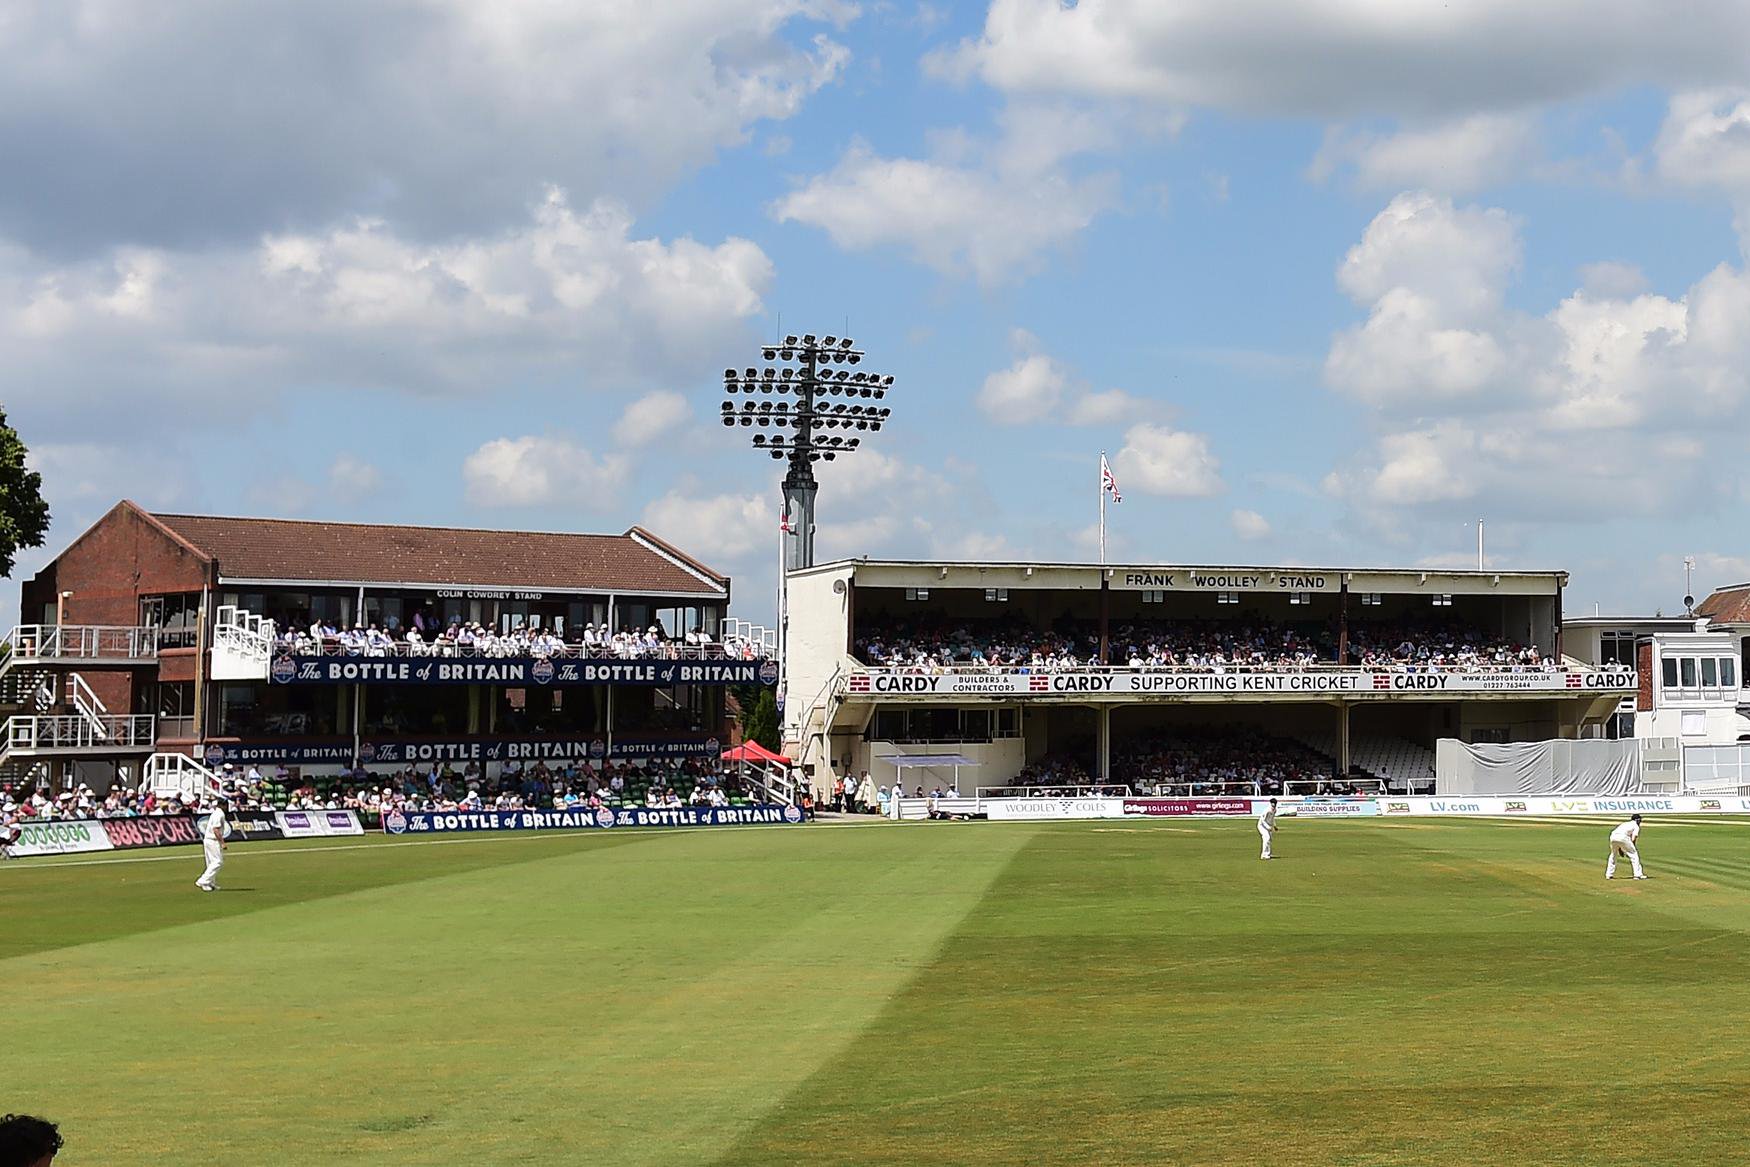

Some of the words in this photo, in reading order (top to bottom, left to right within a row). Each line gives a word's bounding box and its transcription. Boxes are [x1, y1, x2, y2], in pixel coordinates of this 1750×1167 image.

[1126, 575, 1174, 586] FRANK
[1195, 576, 1260, 588] WOOLLEY
[1280, 577, 1325, 588] STAND
[437, 590, 464, 598] COLIN
[467, 591, 510, 599] COWDREY
[298, 662, 322, 680] The
[329, 663, 410, 680] BOTTLE
[416, 662, 432, 682] of
[439, 664, 524, 680] BRITAIN
[558, 664, 580, 681] The
[585, 664, 655, 680] BOTTLE
[660, 664, 676, 682] of
[680, 665, 755, 682] BRITAIN
[875, 676, 940, 692] CARDY
[1053, 676, 1114, 690] CARDY
[1130, 676, 1237, 690] SUPPORTING
[1243, 676, 1285, 690] KENT
[1290, 676, 1359, 690] CRICKET
[1394, 675, 1448, 690] CARDY
[1586, 674, 1636, 688] CARDY
[242, 750, 287, 758] BOTTLE
[304, 748, 352, 758] BRITAIN
[376, 744, 400, 761] The
[405, 743, 480, 760] BOTTLE
[486, 742, 502, 760] of
[508, 742, 586, 758] BRITAIN
[622, 744, 656, 752] BOTTLE
[668, 744, 705, 752] BRITAIN
[1005, 802, 1057, 813] WOODLEY
[1076, 802, 1107, 812] COLES
[1148, 804, 1189, 812] SOLICITORS
[1430, 802, 1480, 812] LV.com
[1594, 800, 1674, 811] INSURANCE
[409, 816, 430, 830] The
[434, 814, 499, 830] BOTTLE
[504, 813, 517, 828] of
[522, 812, 594, 828] BRITAIN
[616, 810, 635, 826] The
[638, 810, 696, 825] BOTTLE
[702, 809, 713, 825] of
[718, 808, 782, 822] BRITAIN
[104, 816, 196, 847] 888SPORT
